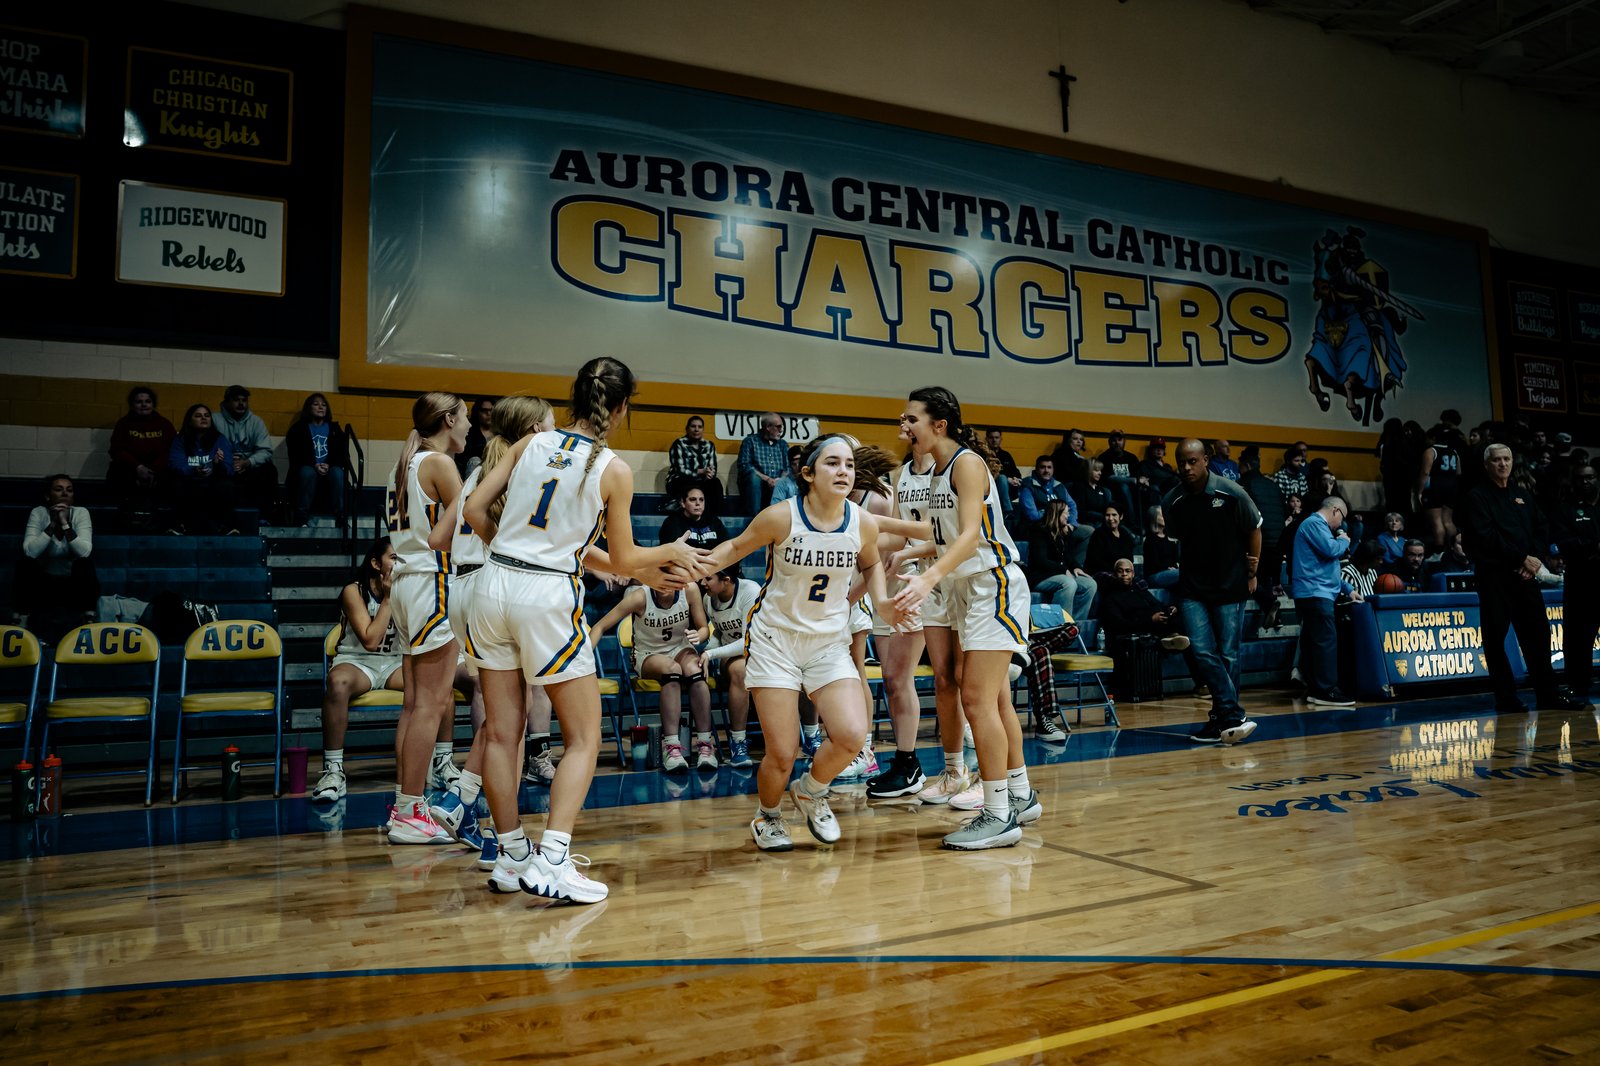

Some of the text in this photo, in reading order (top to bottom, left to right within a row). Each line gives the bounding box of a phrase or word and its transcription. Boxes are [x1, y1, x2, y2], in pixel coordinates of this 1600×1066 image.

[168, 69, 255, 97] CHICAGO
[152, 88, 268, 119] CHRISTIAN
[160, 109, 260, 150] Knights
[0, 210, 56, 233] TION
[139, 206, 267, 239] RIDGEWOOD
[549, 149, 1290, 285] AURORA CENTRAL CATHOLIC
[162, 240, 245, 273] Rebels
[551, 194, 1291, 367] CHARGERS
[1522, 375, 1560, 390] CHRISTIAN
[725, 413, 810, 440] VISIRS
[528, 477, 560, 531] 1
[808, 573, 830, 603] 2
[644, 609, 689, 628] CHARGERS
[715, 618, 742, 633] ARGER
[1402, 610, 1465, 628] WELCOME TO
[3, 629, 24, 658] C
[73, 628, 143, 654] ACC
[201, 625, 265, 651] ACC
[662, 627, 673, 641] 5
[1383, 629, 1437, 653] AURORA
[1415, 652, 1475, 678] CATHOLIC
